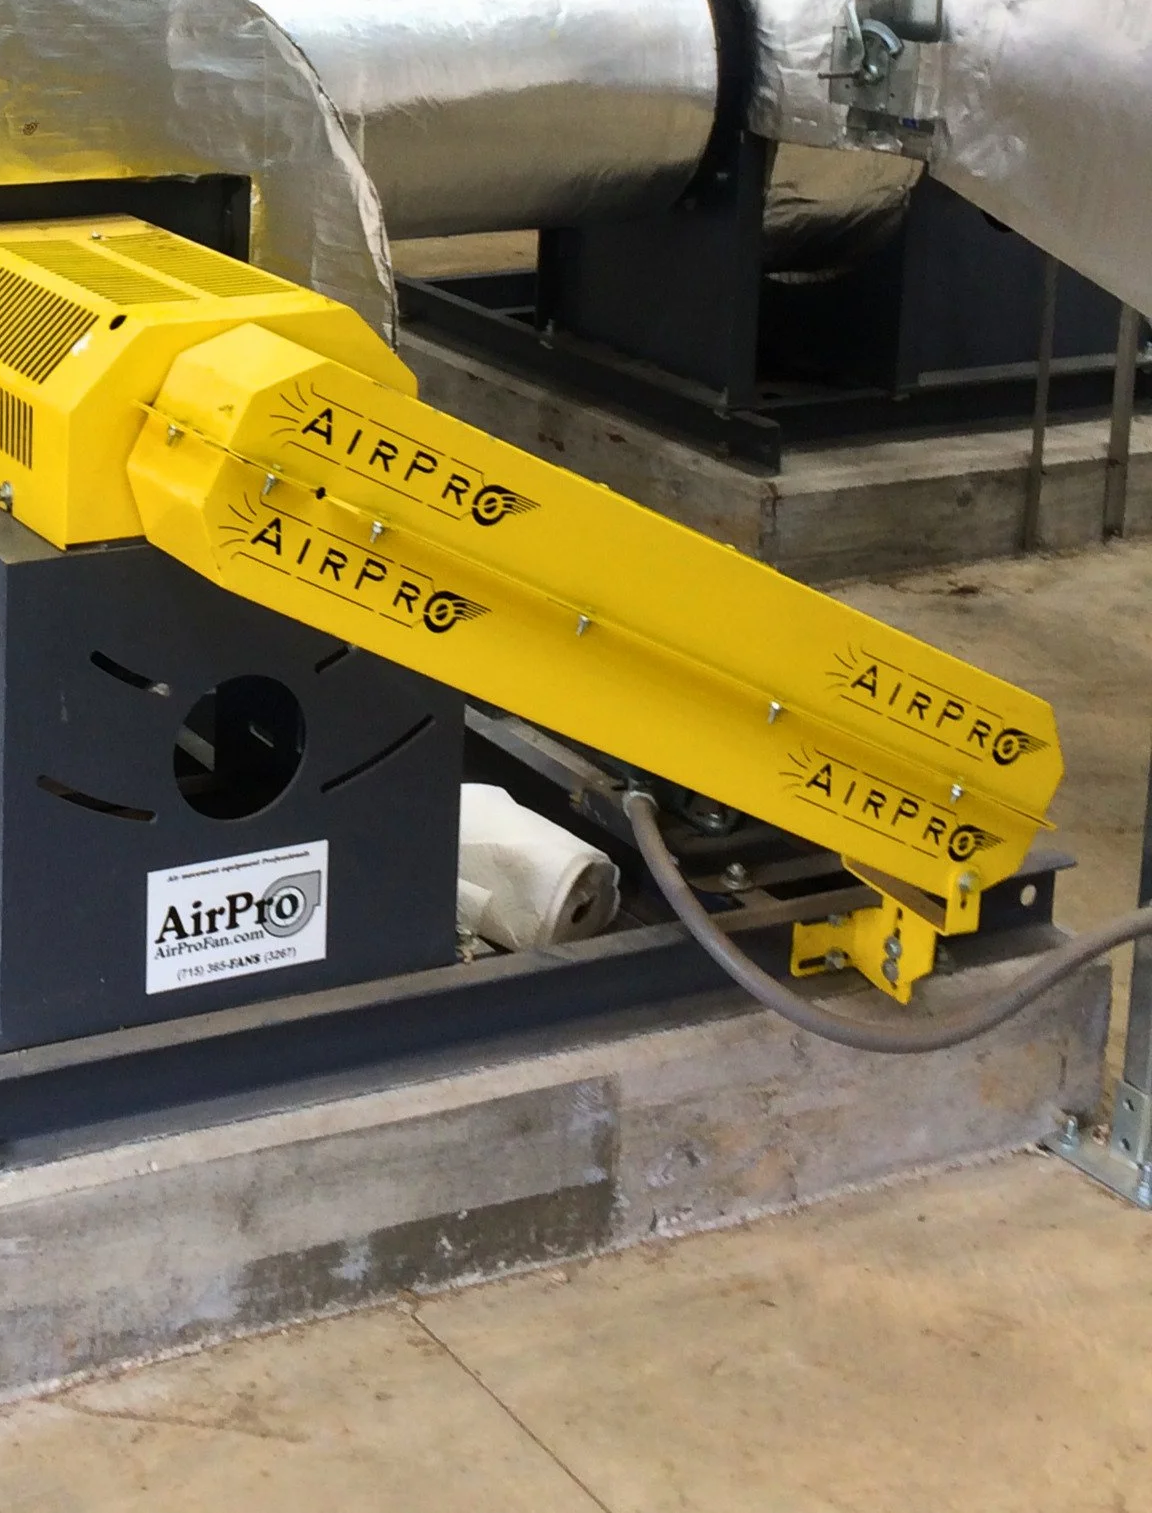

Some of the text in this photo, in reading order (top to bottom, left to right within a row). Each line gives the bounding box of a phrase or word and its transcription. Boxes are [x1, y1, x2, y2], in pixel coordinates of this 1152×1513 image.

[302, 407, 514, 526] AIRPRO
[251, 517, 464, 633] AIRPRO
[850, 665, 1025, 765] AIRPRO
[805, 763, 982, 862] AIRPRO
[155, 891, 299, 943] AirPro
[155, 929, 265, 960] AirProFan.com
